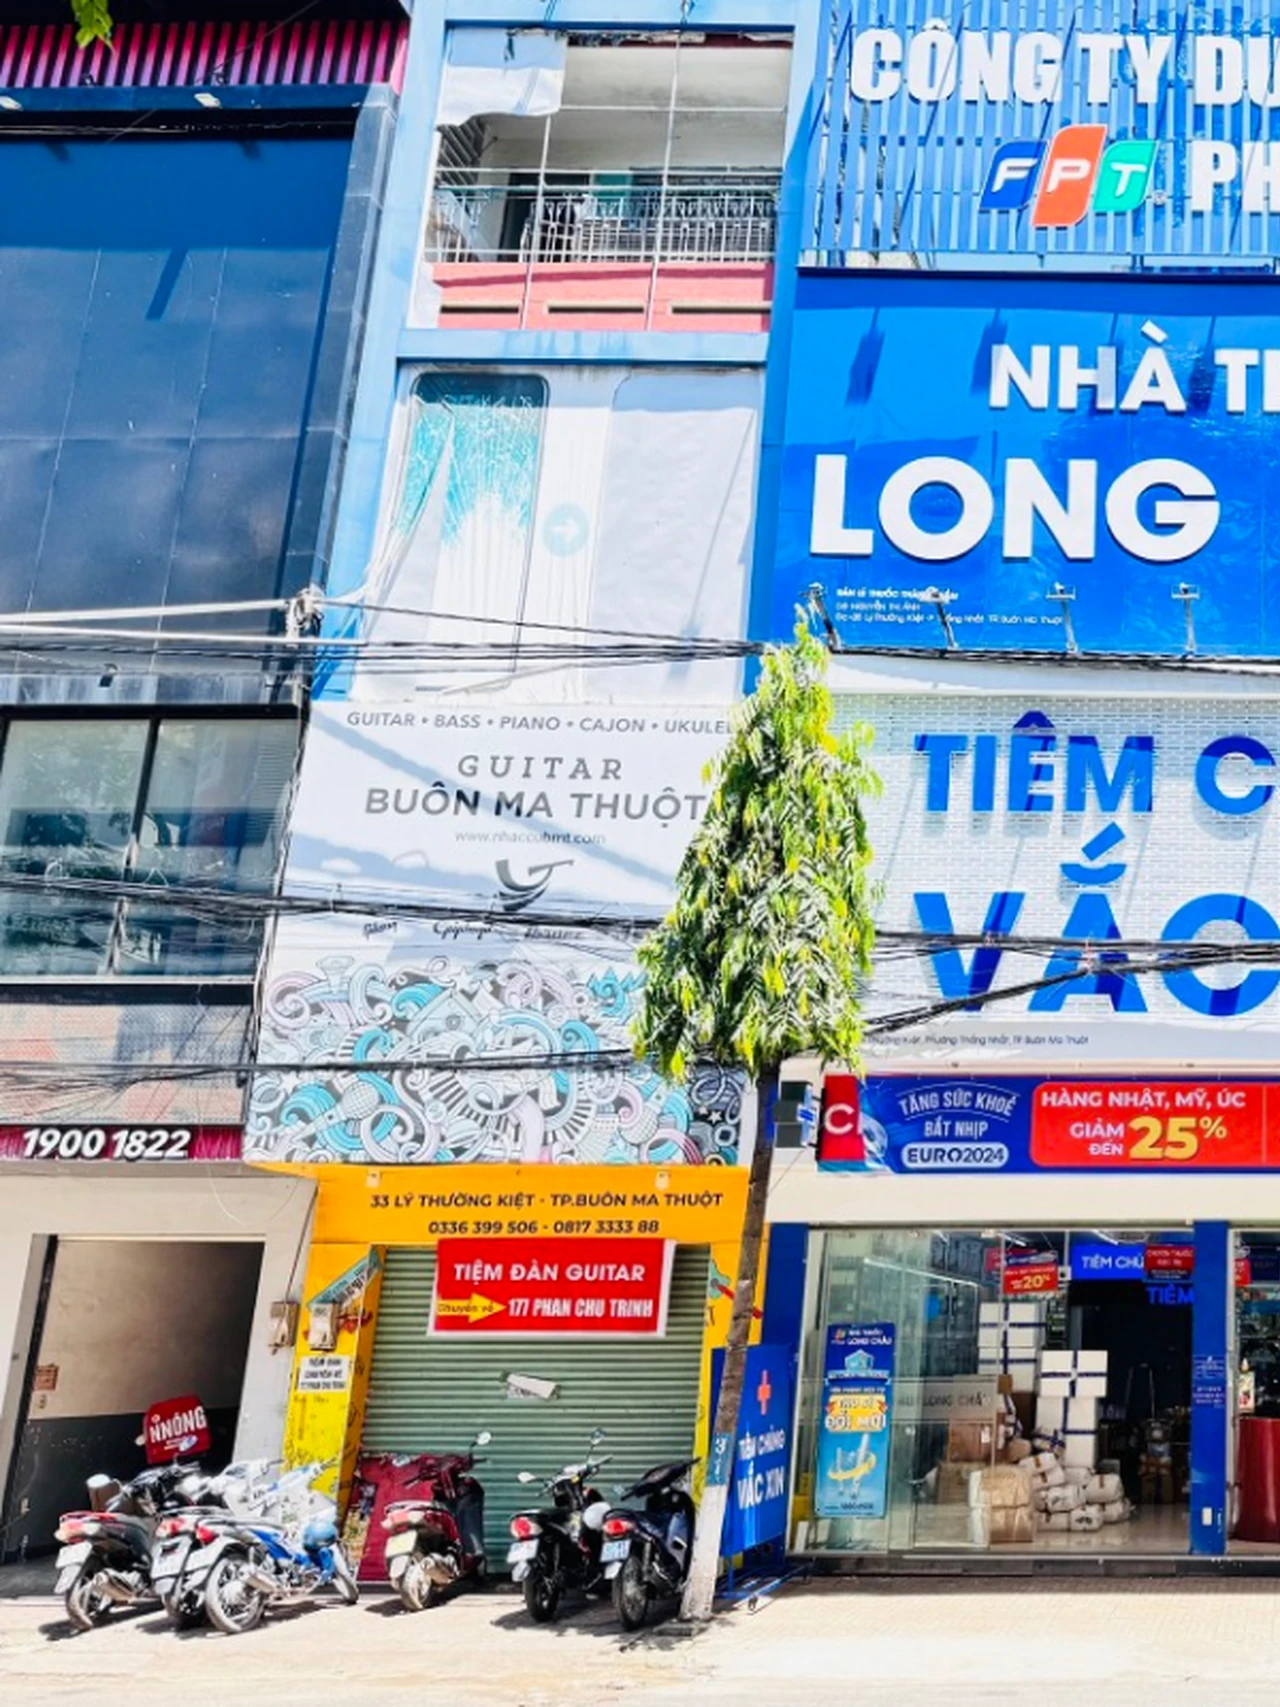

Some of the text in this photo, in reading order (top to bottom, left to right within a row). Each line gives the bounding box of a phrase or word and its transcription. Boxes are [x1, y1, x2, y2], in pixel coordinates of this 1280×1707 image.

[851, 22, 1058, 104] CÔNG
[1079, 35, 1176, 106] TY
[990, 320, 1188, 412] NHÀ
[810, 453, 1220, 561] LONG
[347, 711, 415, 728] GUITAR
[434, 714, 481, 729] BASS
[499, 716, 560, 731] PIANO
[579, 718, 646, 733] CAJON
[458, 755, 623, 780] GUITAR
[914, 710, 1155, 814] TIÊM
[365, 781, 707, 828] BUÔN MA THUỘT
[899, 1090, 940, 1115] TĂNG
[943, 1087, 974, 1110] SỨC
[1042, 1085, 1246, 1112] HÀNG NHẬT, MỸ, ÚC
[22, 1128, 191, 1159] 1900 1822
[954, 1121, 989, 1142] NHỊP
[1070, 1116, 1228, 1160] GIẢM ĐẾN 25%
[907, 1147, 1005, 1164] EURO2024
[371, 1190, 724, 1211] 33 LÝ THƯỜNG KIỆT TP.BUÔN MA THUỘT
[429, 1221, 659, 1234] 0336 399 506 0817 3333 88
[454, 1258, 646, 1285] TIỆM ĐÀN GUITAR
[1114, 1252, 1145, 1269] CHỦ
[508, 1298, 653, 1317] 177 PHAN CHU TRINH
